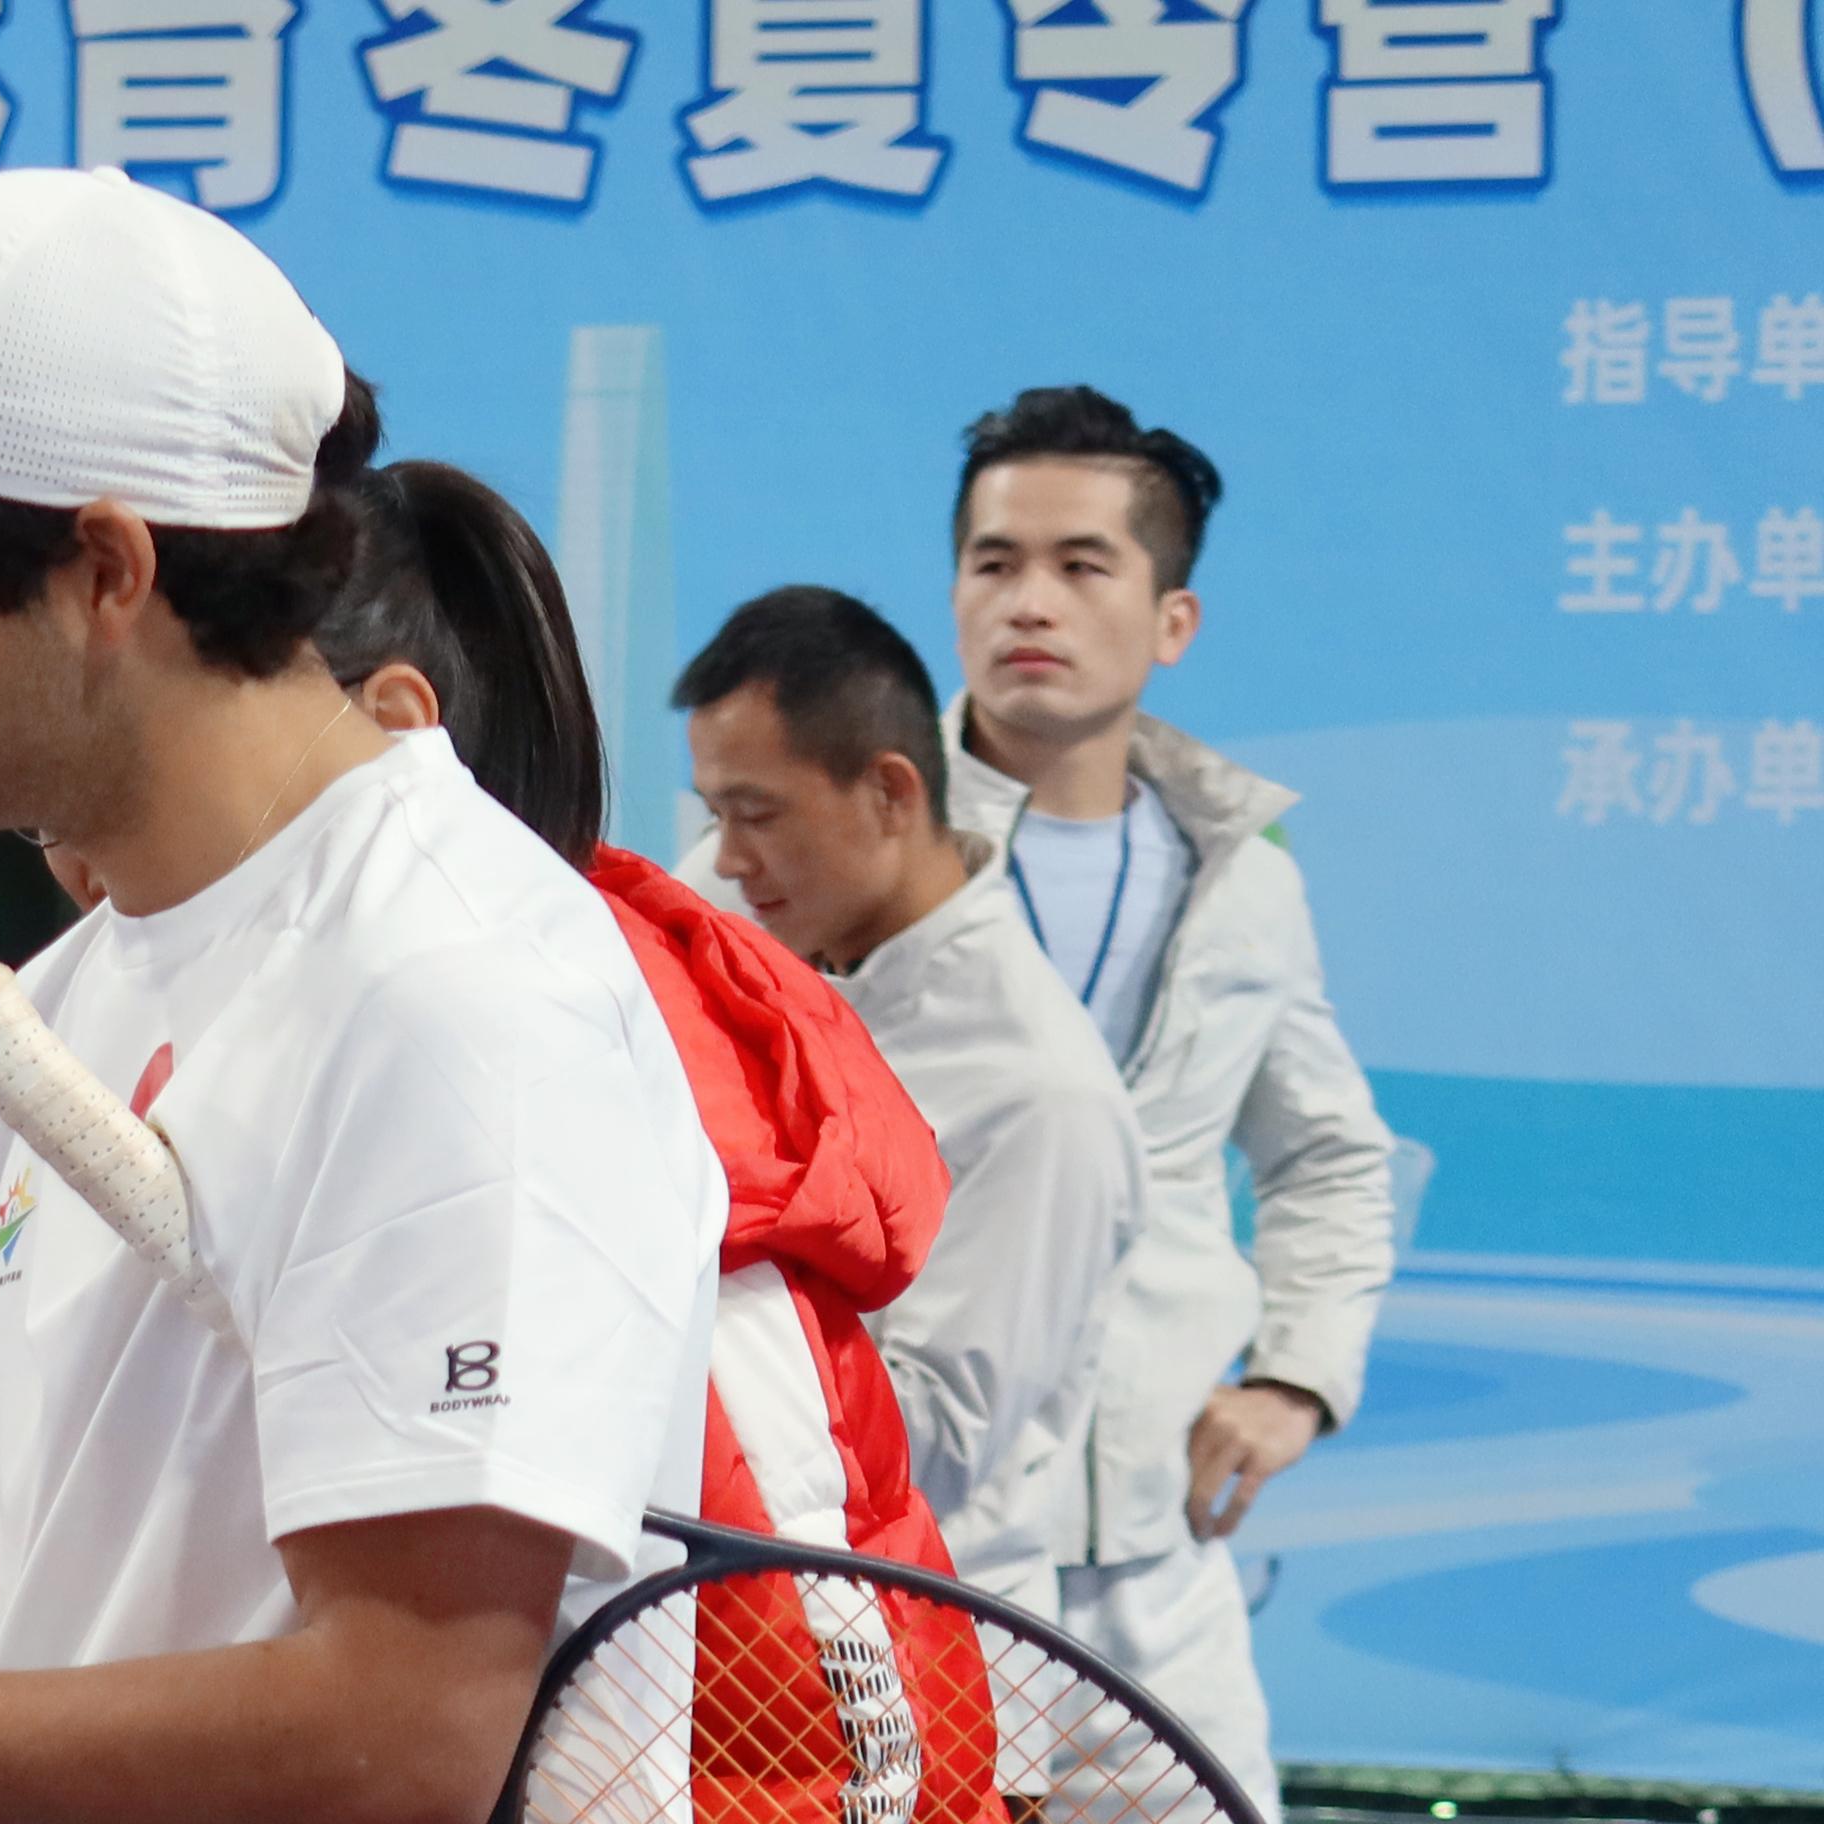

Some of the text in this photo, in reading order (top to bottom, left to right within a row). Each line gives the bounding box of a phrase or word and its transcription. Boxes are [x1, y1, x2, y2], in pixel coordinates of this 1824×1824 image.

[1560, 296, 1824, 403] 指导单
[1558, 506, 1824, 614] 主办单
[1557, 718, 1824, 824] 承办单
